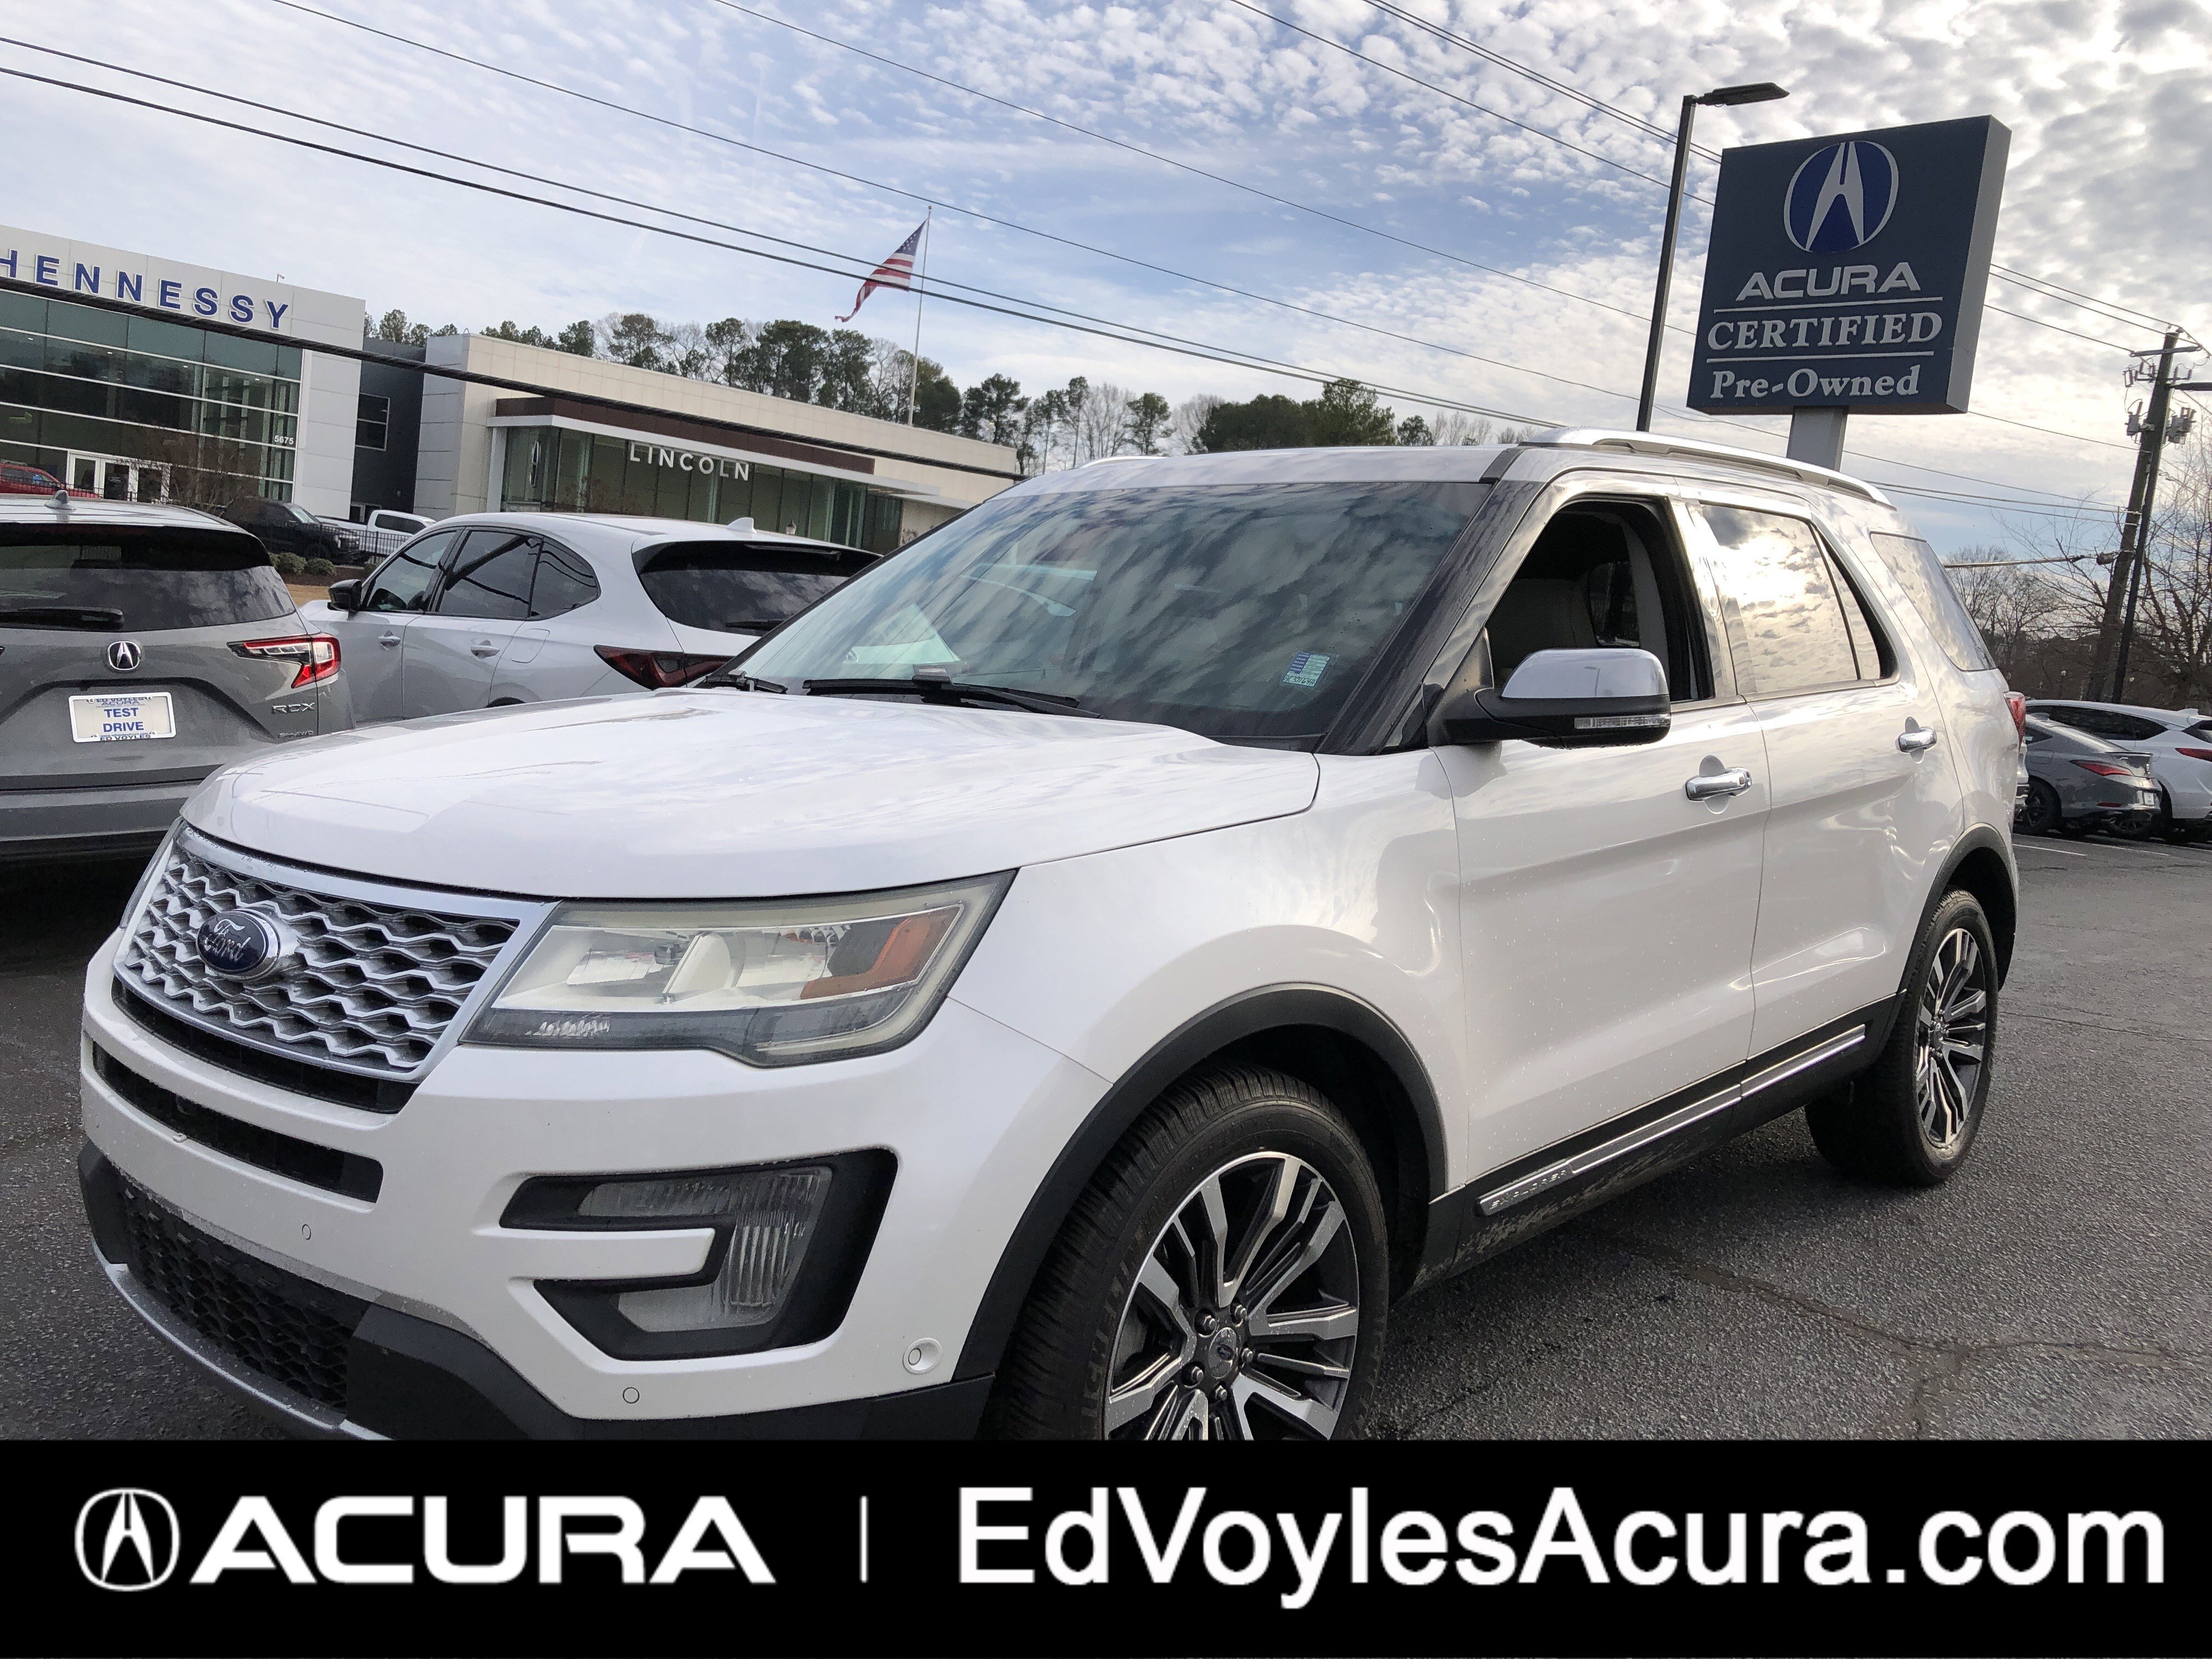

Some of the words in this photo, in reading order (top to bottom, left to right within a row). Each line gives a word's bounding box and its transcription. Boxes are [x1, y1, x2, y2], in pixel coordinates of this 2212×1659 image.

[1735, 261, 1921, 302] ACURA
[1707, 311, 1943, 351] CERTIFIED
[1710, 364, 1921, 399] Pre-Owned
[274, 435, 294, 445] 5675
[630, 443, 749, 481] LINCOLN
[103, 707, 139, 718] TEST
[272, 702, 315, 713] RDX
[103, 721, 144, 732] DRIVE
[204, 918, 252, 962] Ford
